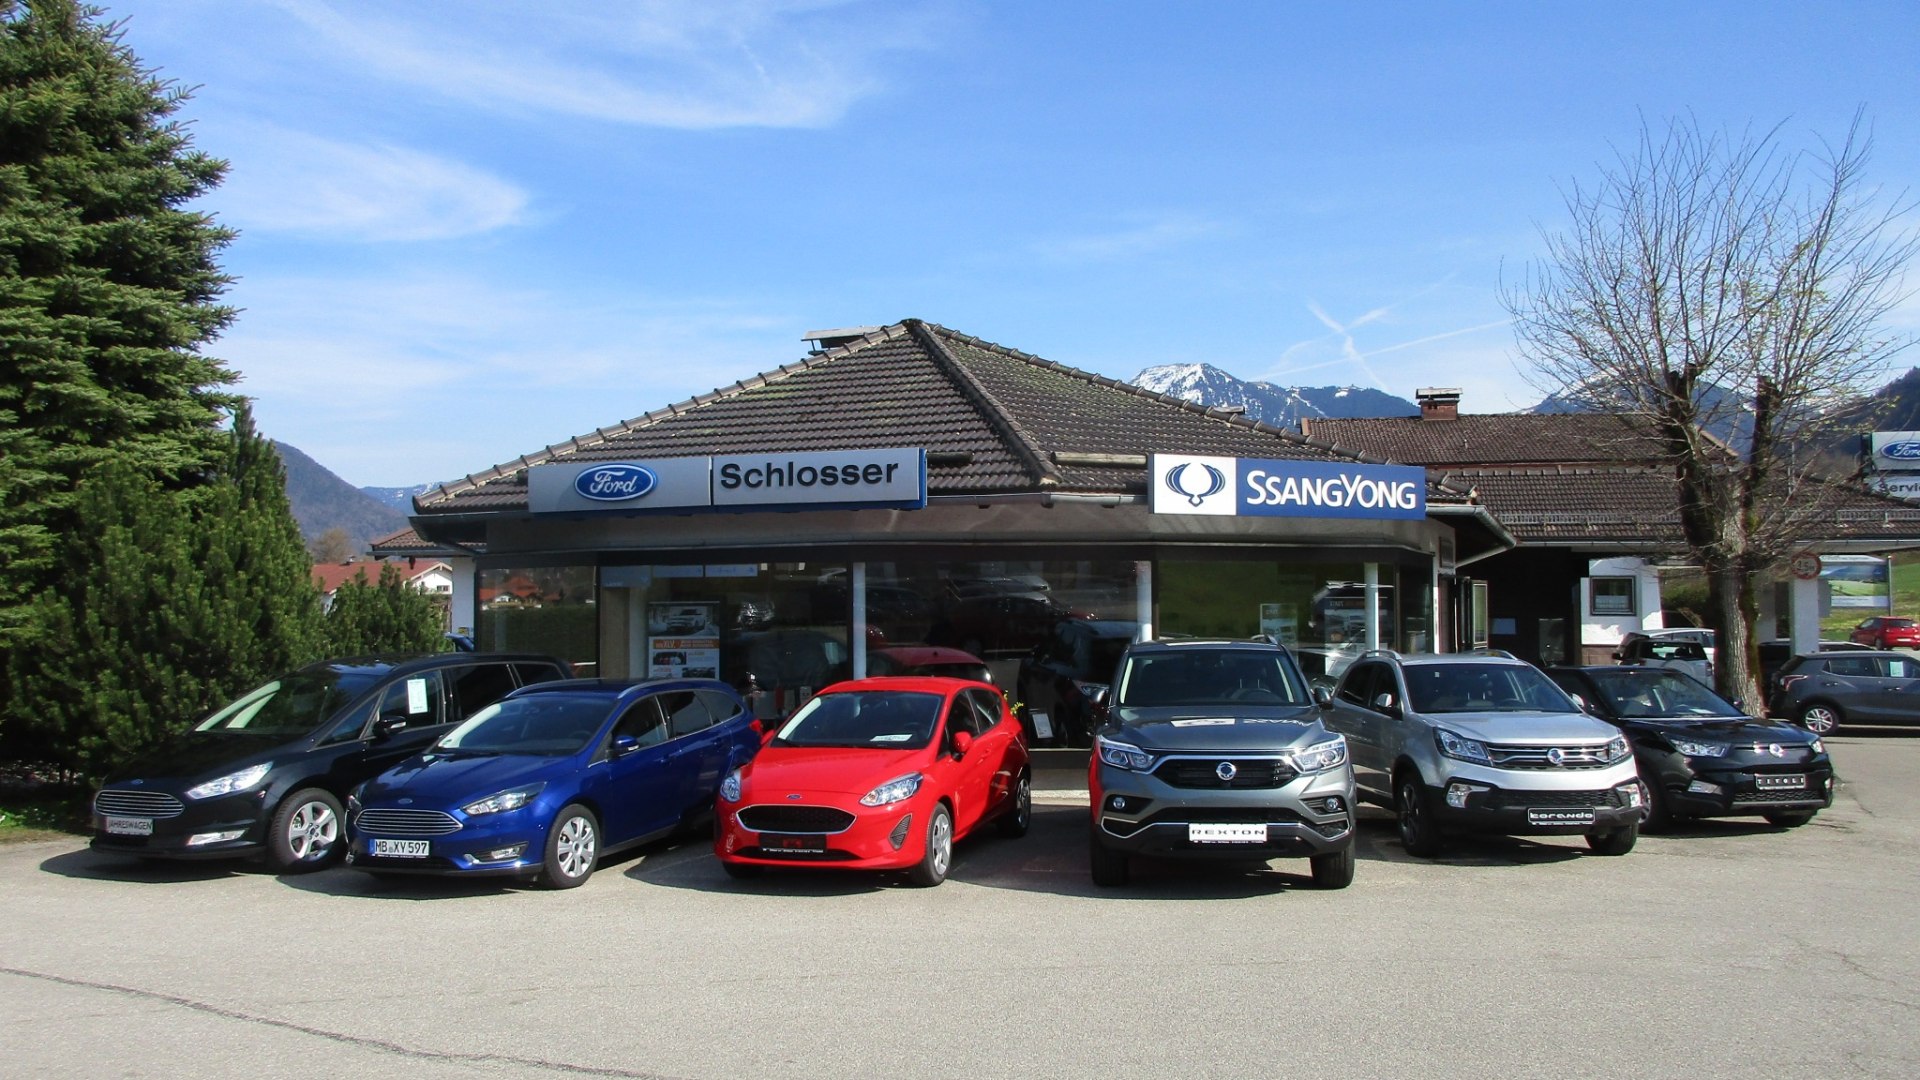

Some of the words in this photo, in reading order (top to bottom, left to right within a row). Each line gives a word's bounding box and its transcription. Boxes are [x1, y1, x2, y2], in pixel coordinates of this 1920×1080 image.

[589, 470, 638, 494] Ford
[720, 461, 899, 489] Schlosser
[1246, 470, 1416, 509] SSANGYONG
[1191, 828, 1265, 836] REXTON
[375, 840, 388, 853] MB
[393, 841, 407, 854] XY
[407, 842, 428, 855] 597
